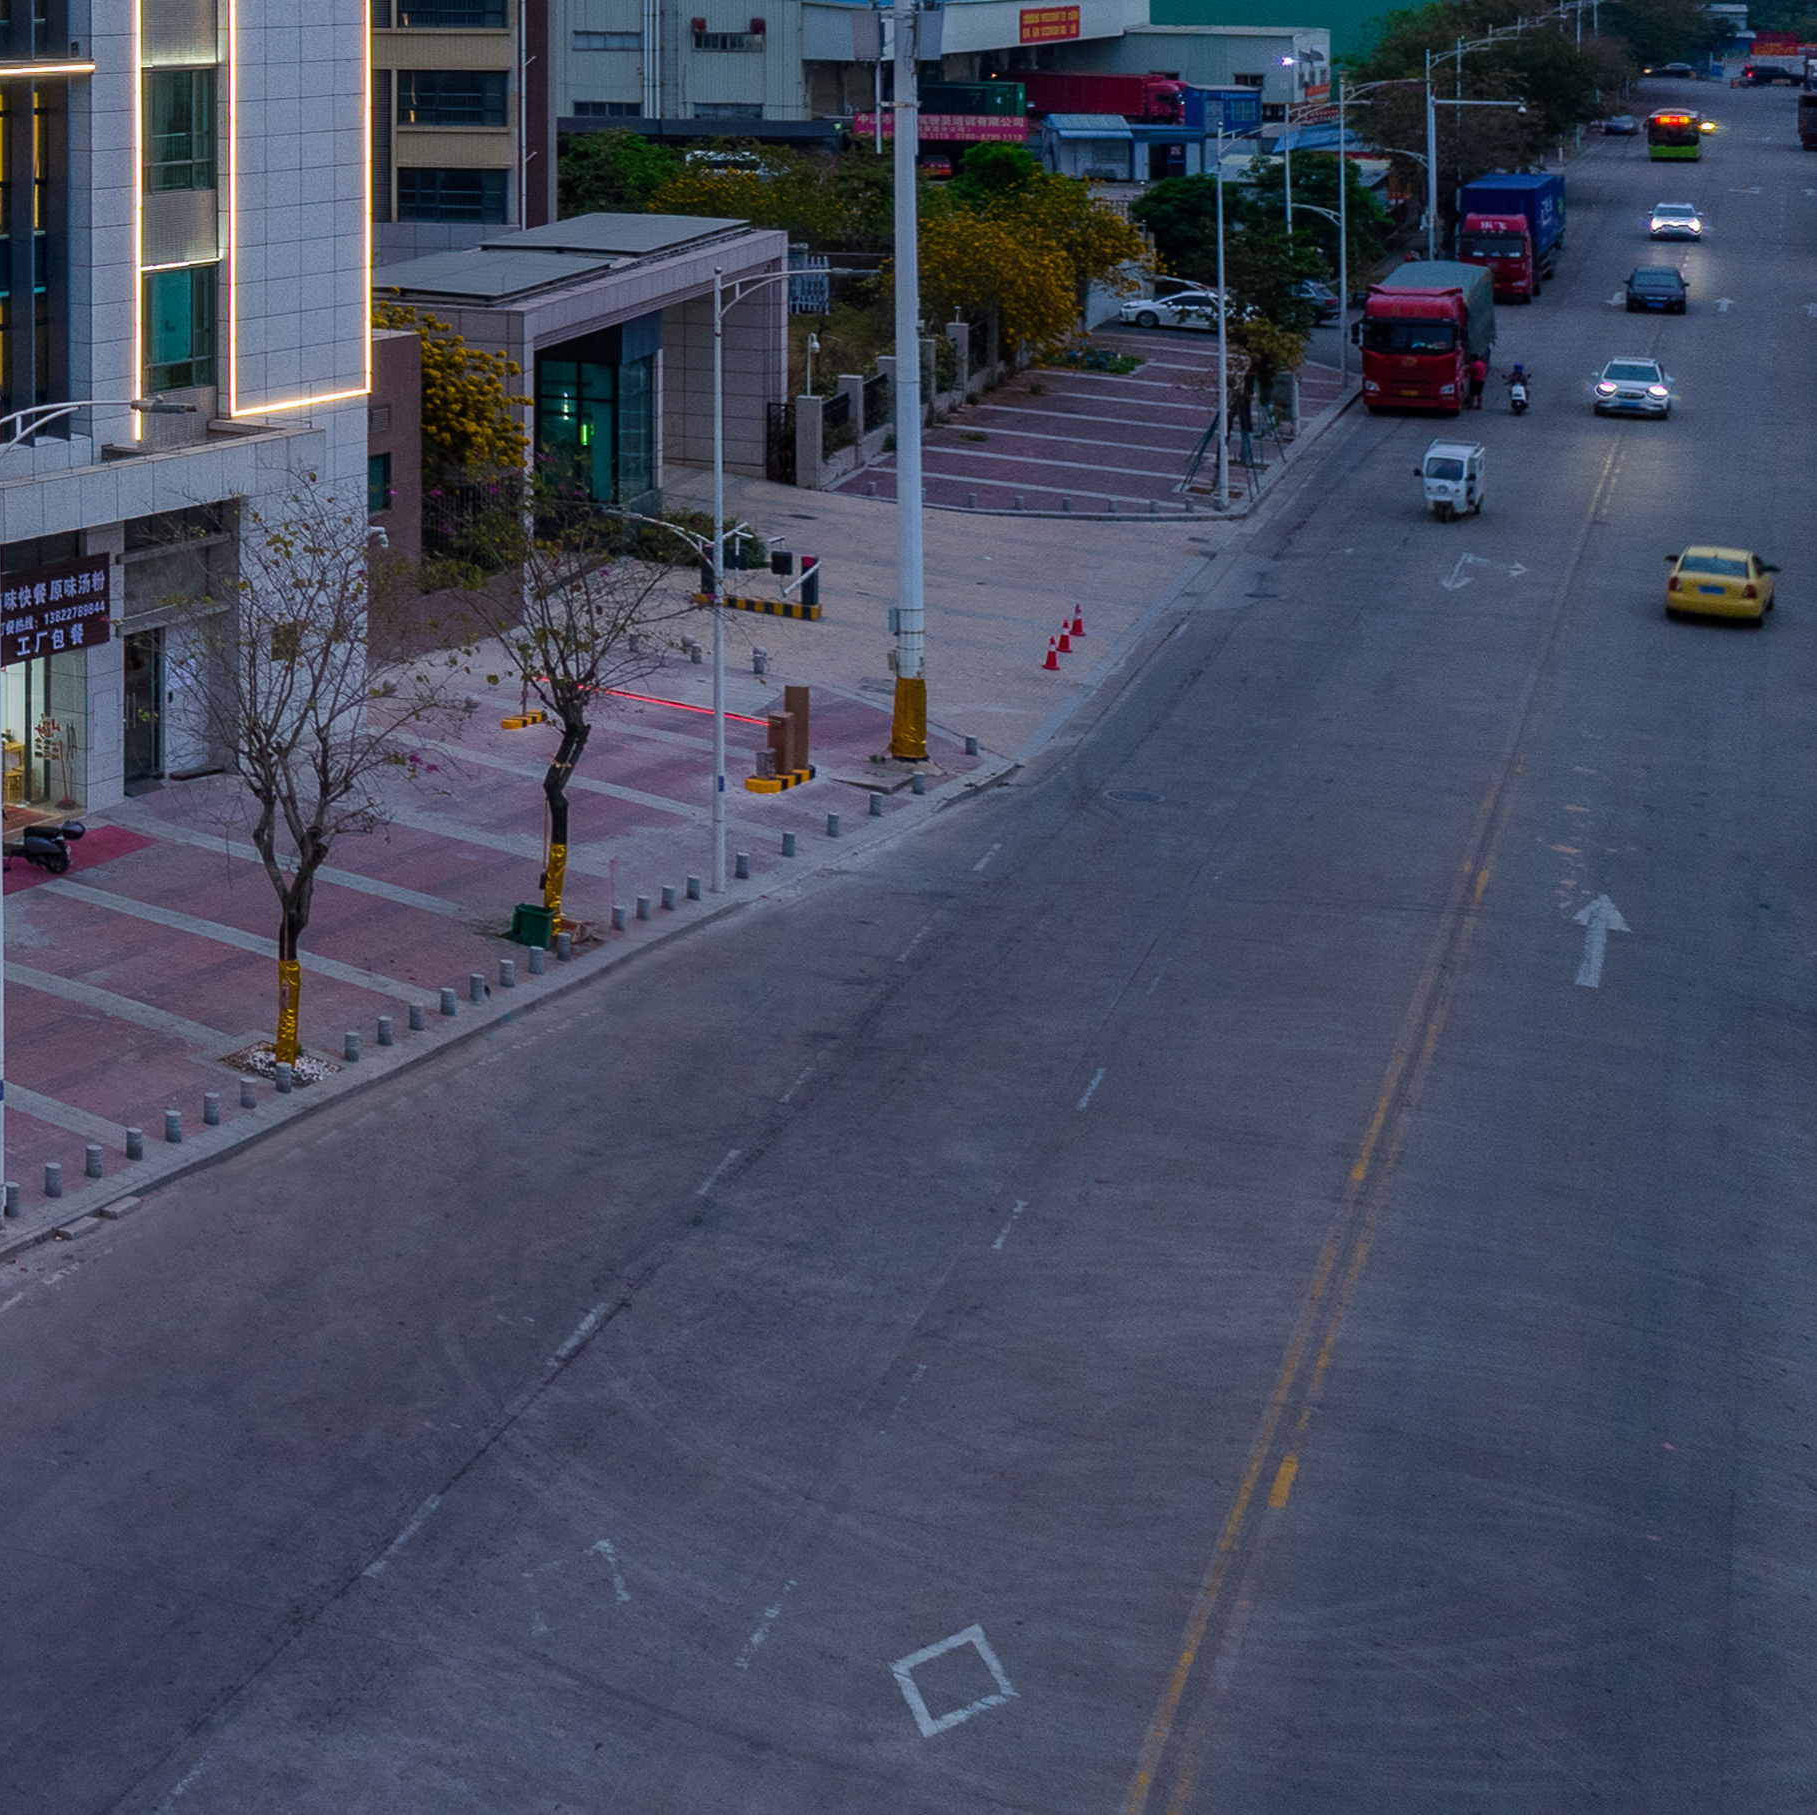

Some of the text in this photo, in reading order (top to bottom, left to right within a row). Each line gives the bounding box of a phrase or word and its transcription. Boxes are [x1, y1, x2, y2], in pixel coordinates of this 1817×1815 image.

[0, 569, 105, 611] 味快餐 原味汤粉
[16, 622, 84, 656] 工厂包餐
